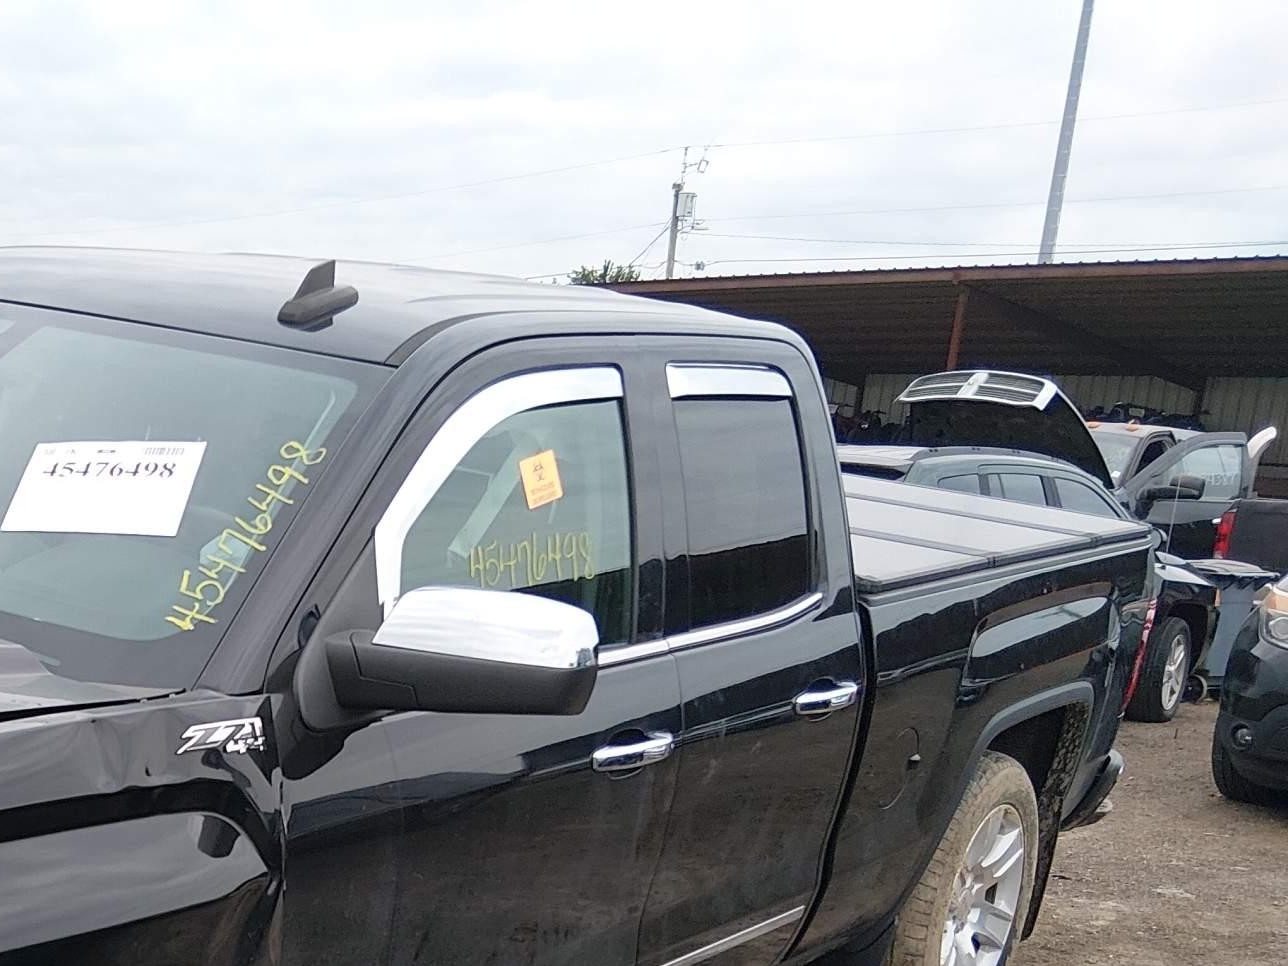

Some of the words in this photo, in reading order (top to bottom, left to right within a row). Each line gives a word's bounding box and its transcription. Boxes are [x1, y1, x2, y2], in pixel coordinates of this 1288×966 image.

[43, 462, 176, 478] 45476498
[165, 440, 327, 631] 45476498
[470, 531, 595, 588] 45476498
